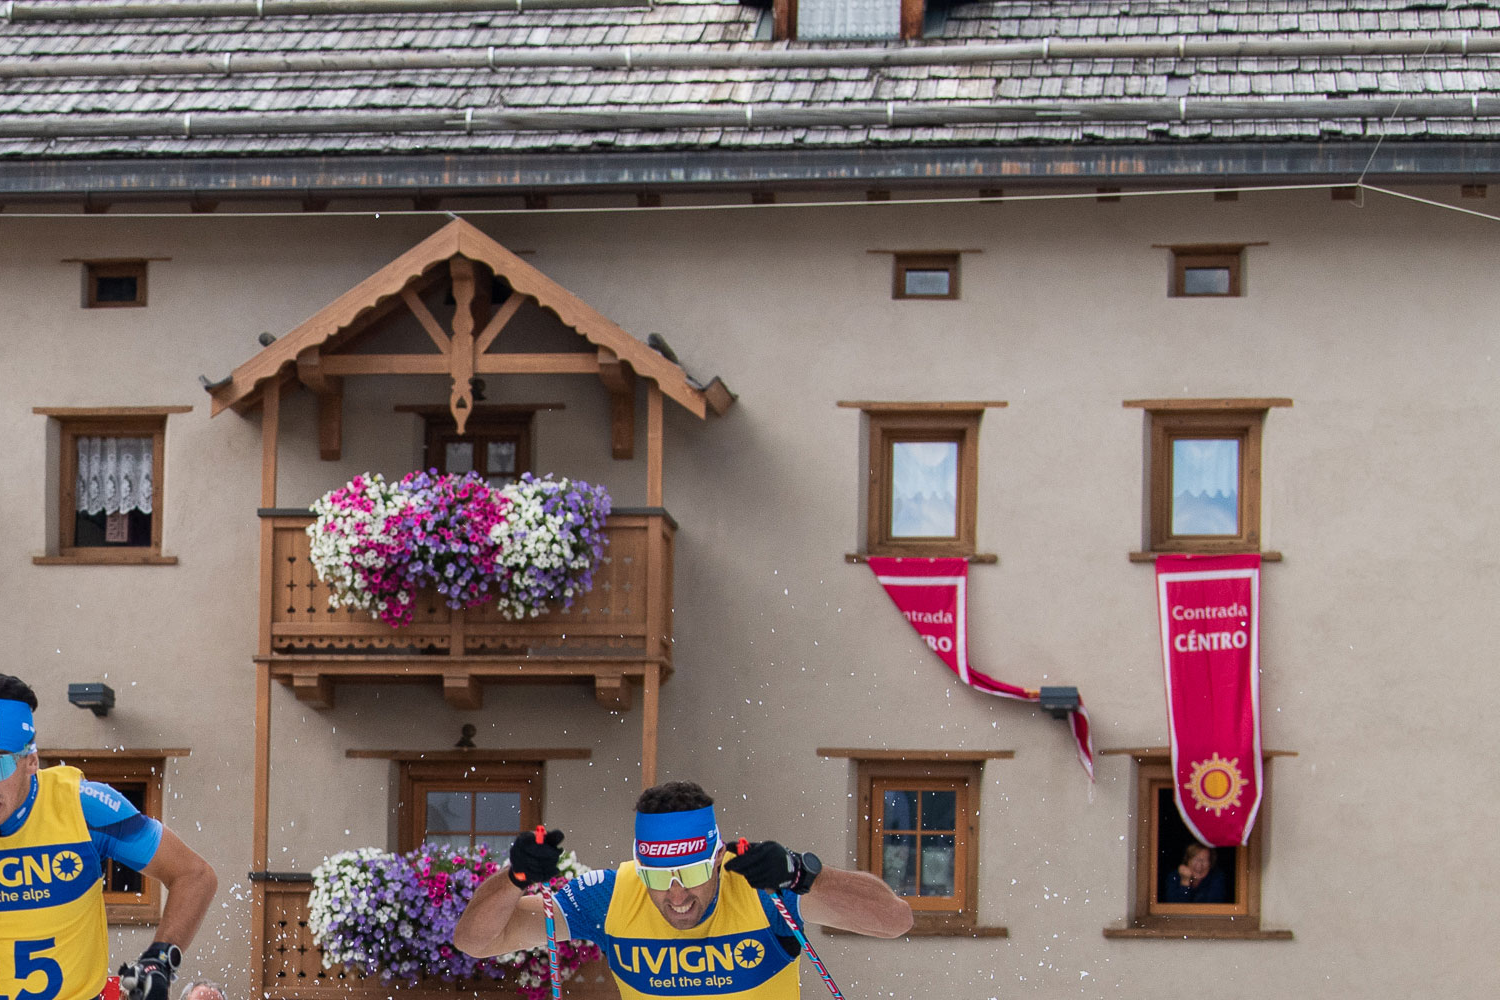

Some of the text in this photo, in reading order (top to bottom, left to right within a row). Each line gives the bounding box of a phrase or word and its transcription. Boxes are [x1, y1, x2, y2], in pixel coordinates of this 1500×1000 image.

[1172, 603, 1248, 620] Contrada
[1174, 629, 1248, 653] CÉNTRO
[648, 838, 706, 856] ENERVIT
[22, 888, 51, 902] alps
[613, 938, 766, 975] LIVIGNO
[650, 975, 733, 988] feel the alps
